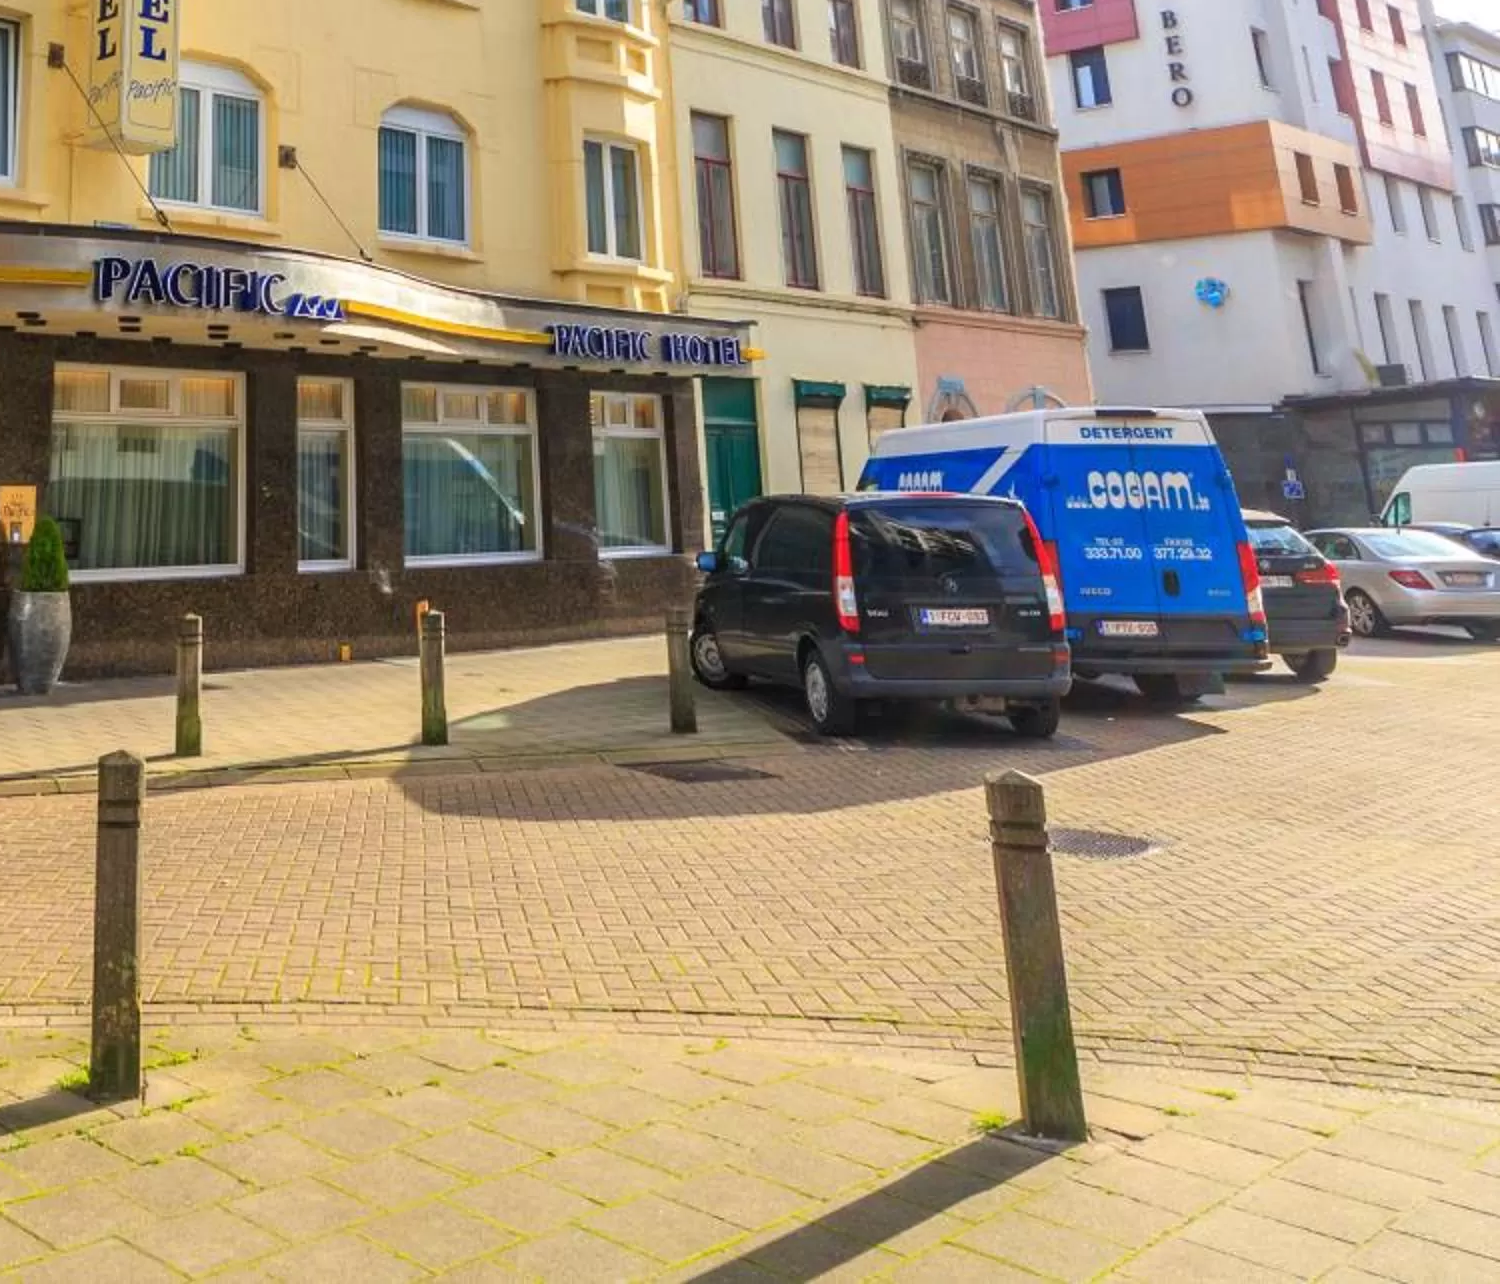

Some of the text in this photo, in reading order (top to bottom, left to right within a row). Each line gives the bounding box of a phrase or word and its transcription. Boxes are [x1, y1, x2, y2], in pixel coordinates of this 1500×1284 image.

[1159, 10, 1194, 108] BERO
[126, 77, 177, 104] Pacific
[94, 256, 287, 316] PACIFIC
[551, 323, 748, 365] PACIFIC HOTEL
[1079, 427, 1174, 439] DETERGENT
